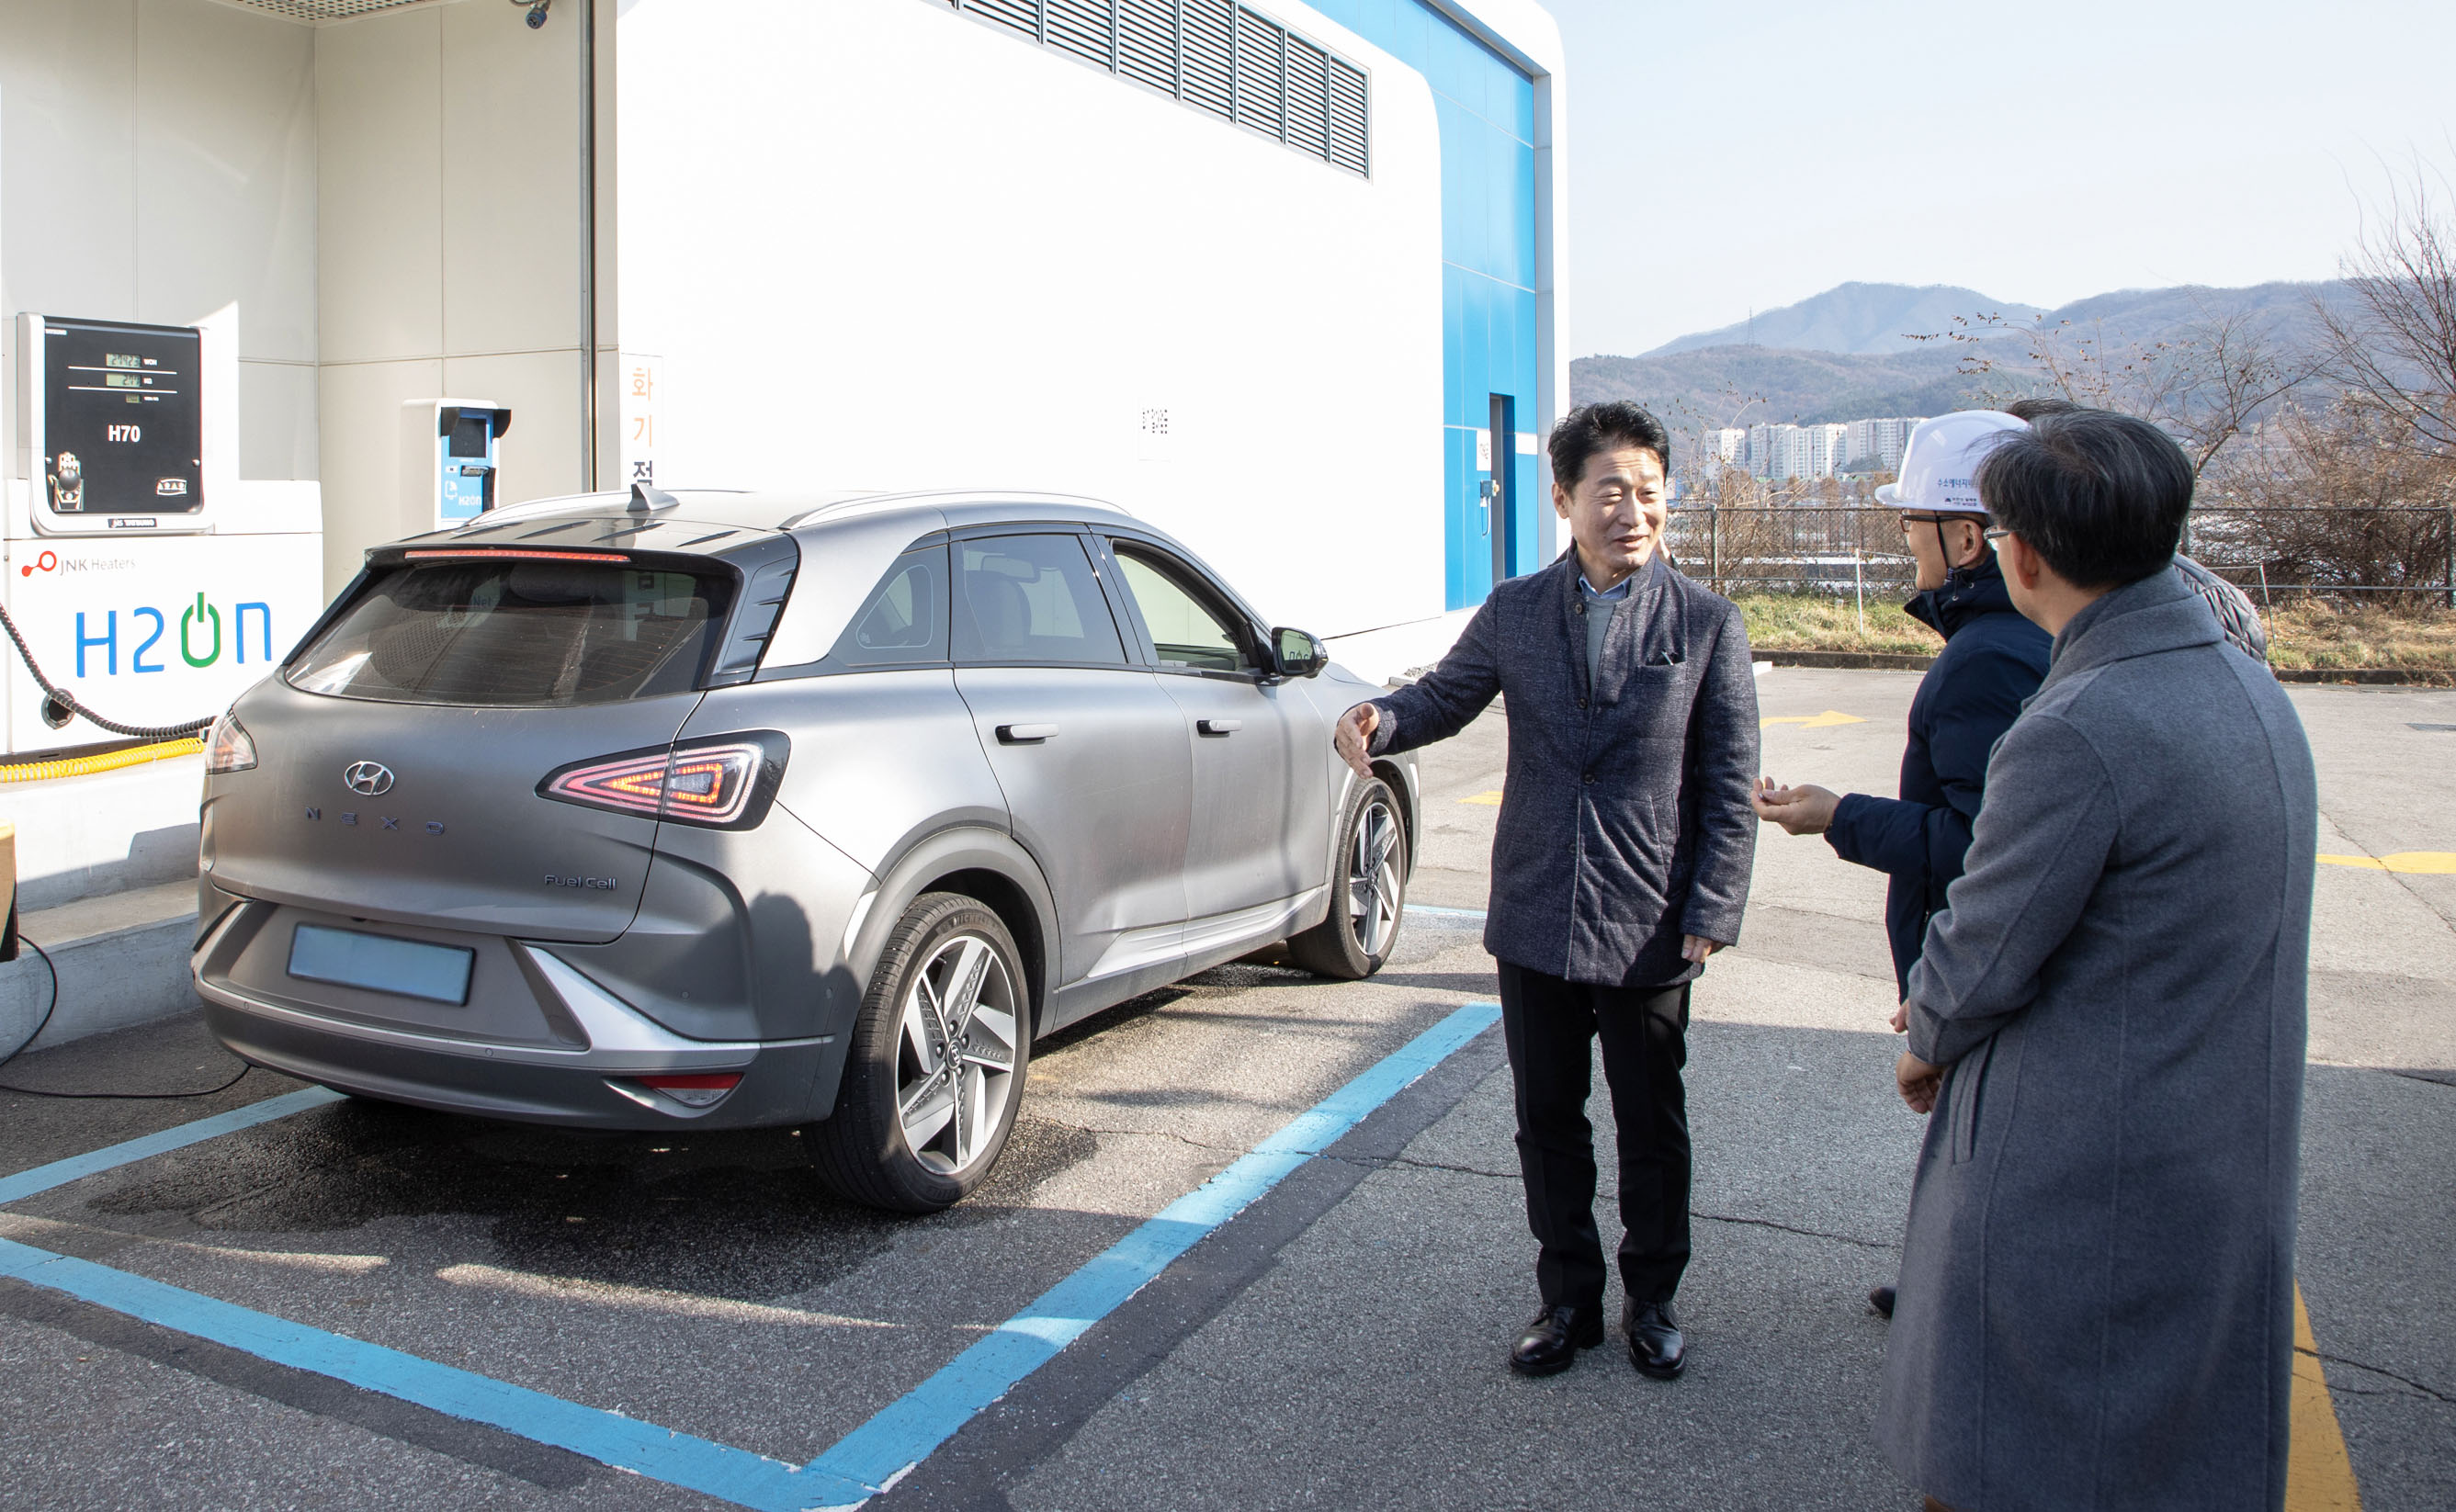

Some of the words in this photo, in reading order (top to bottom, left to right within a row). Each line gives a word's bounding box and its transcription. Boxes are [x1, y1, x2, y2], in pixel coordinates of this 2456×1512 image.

[108, 424, 141, 443] H70
[60, 559, 88, 577] JNK
[91, 558, 136, 571] Heaters
[305, 807, 445, 835] NEXO
[544, 874, 582, 887] Fuel
[585, 877, 617, 890] Cell
